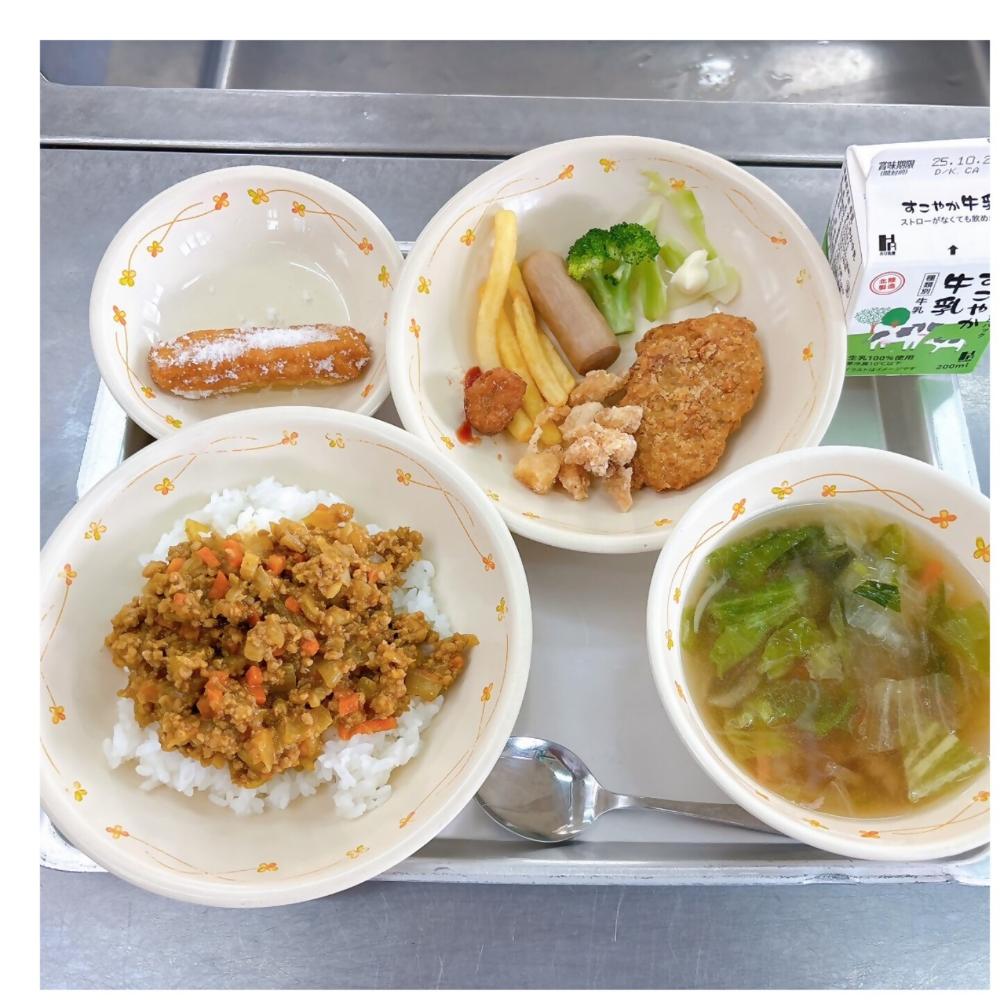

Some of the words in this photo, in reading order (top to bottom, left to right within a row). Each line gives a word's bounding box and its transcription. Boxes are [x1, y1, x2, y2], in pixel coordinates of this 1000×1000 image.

[901, 215, 990, 225] ストローがなくても飲め
[931, 273, 975, 315] 牛乳
